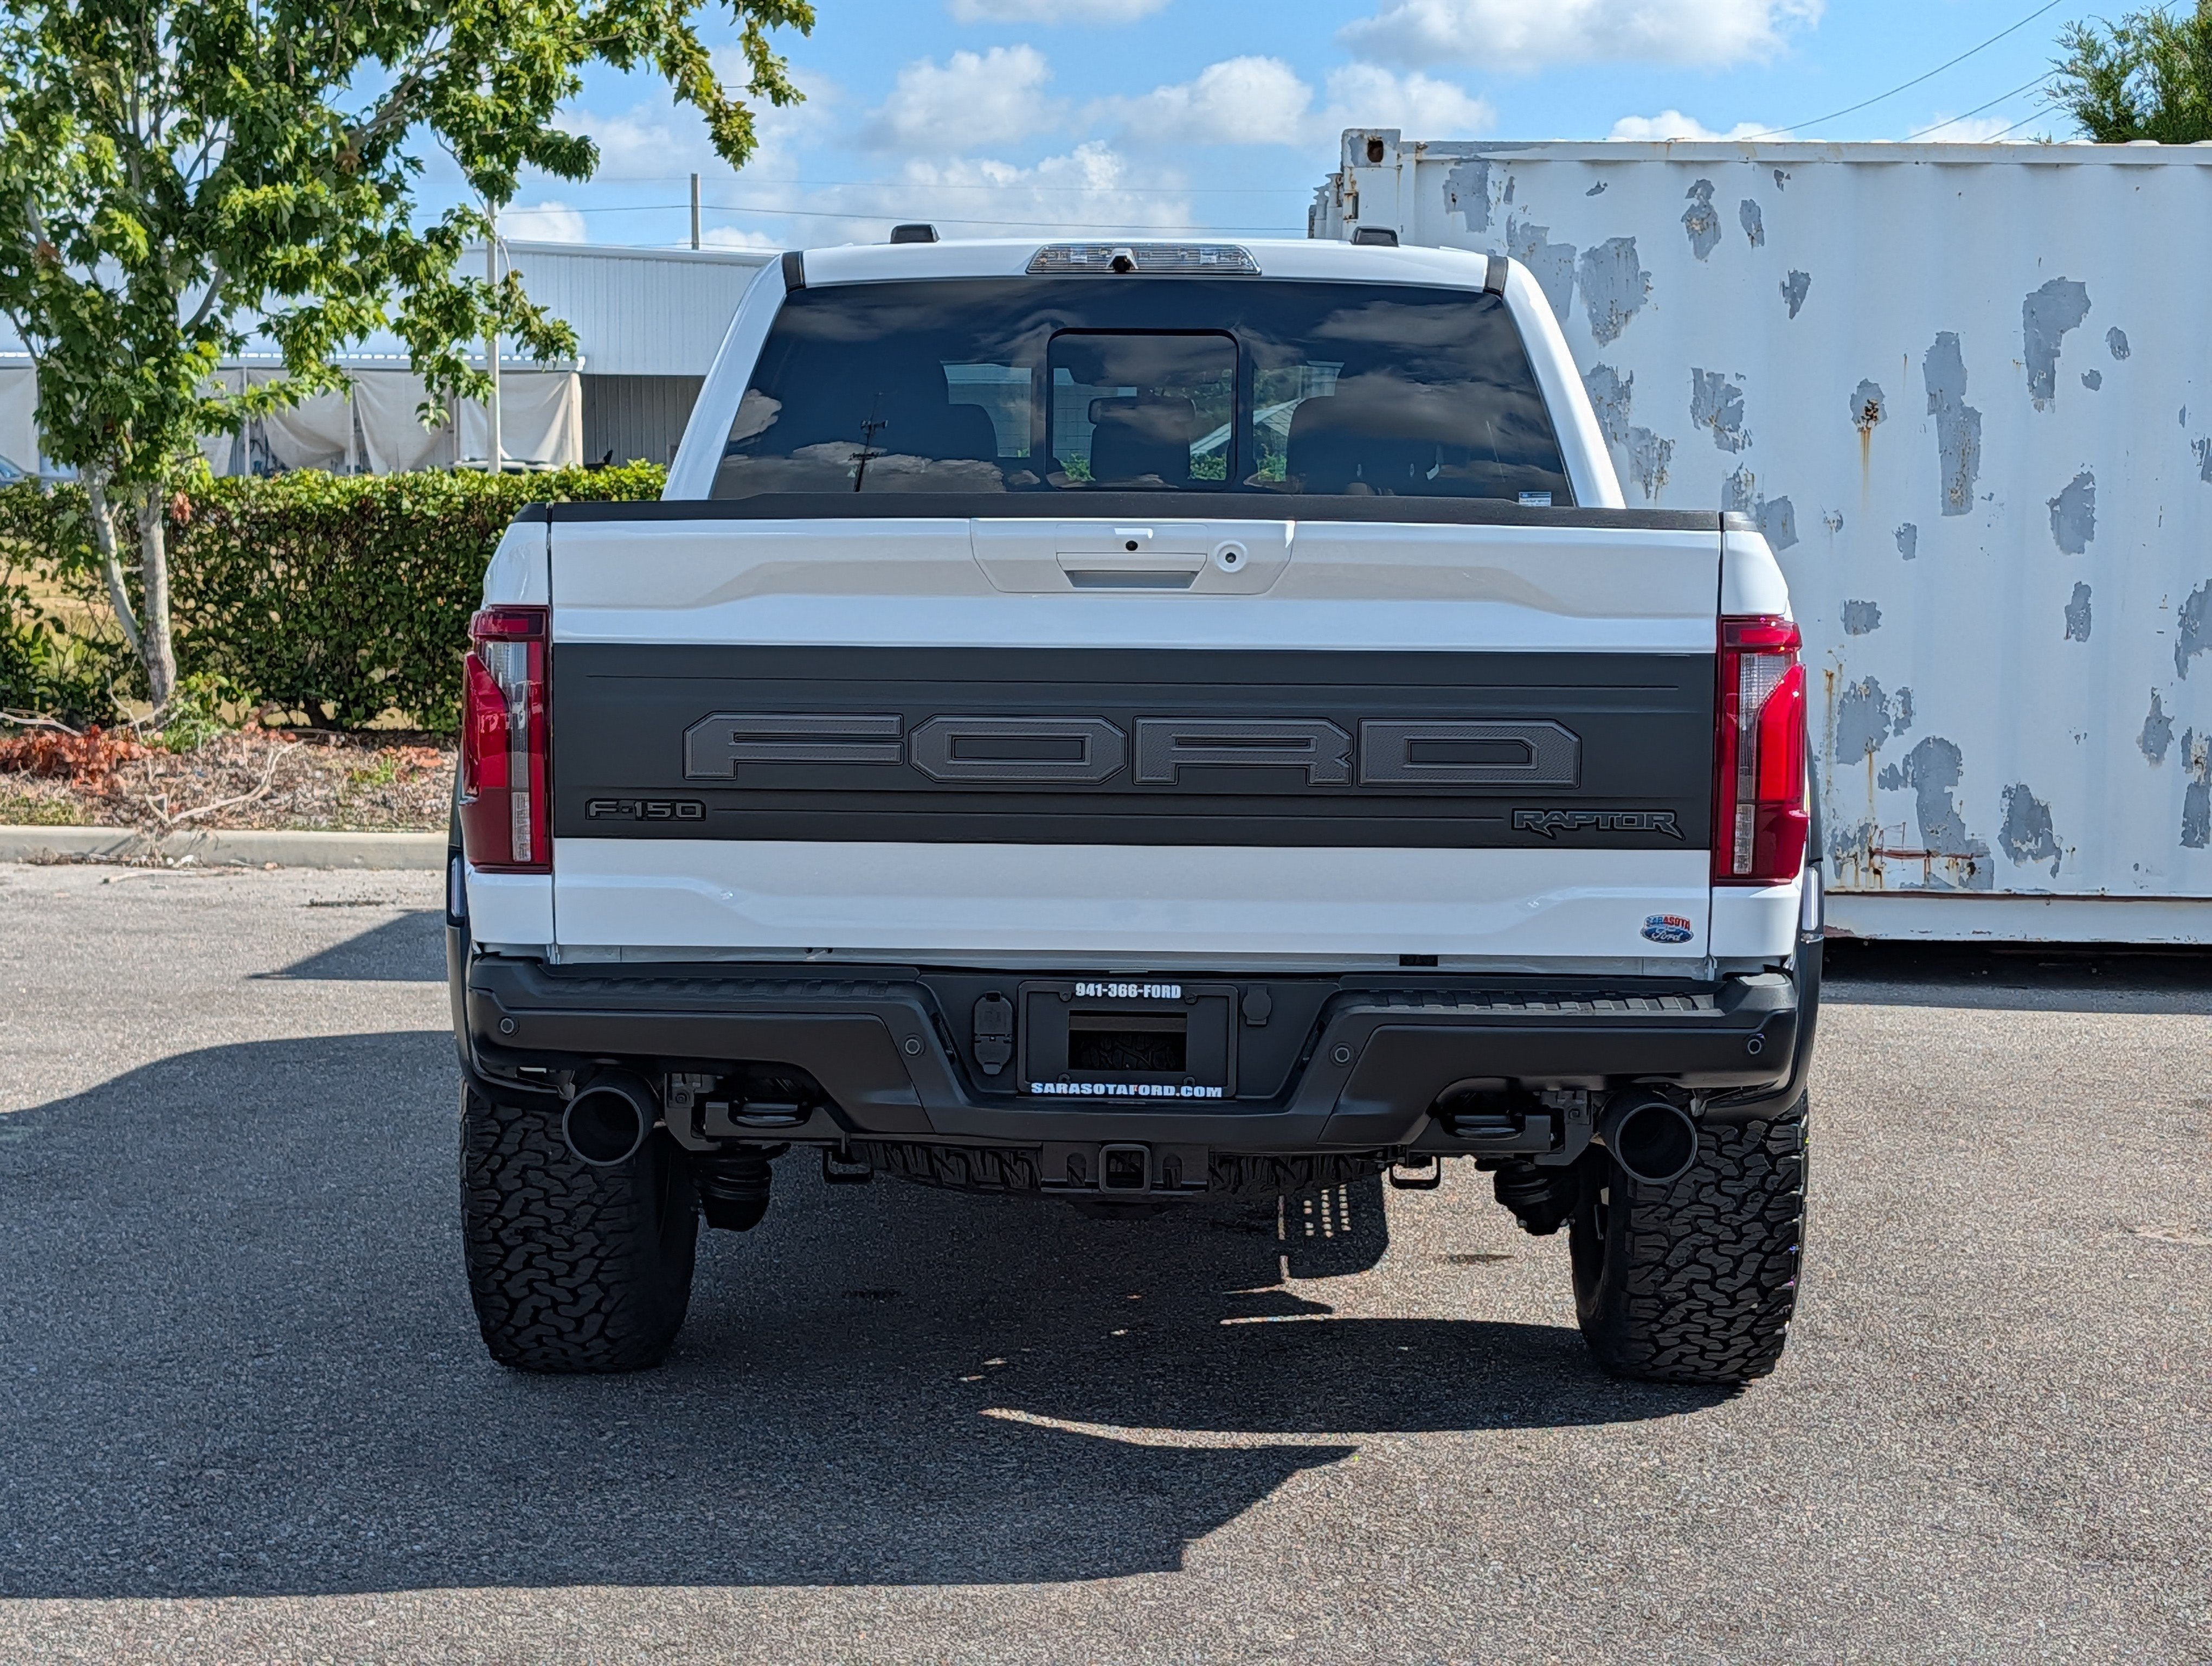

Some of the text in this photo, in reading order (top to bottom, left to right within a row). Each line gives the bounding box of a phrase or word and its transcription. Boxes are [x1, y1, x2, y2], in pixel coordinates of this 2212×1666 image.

[683, 710, 1582, 789] FORD
[587, 799, 705, 820] F-150
[1513, 809, 1686, 841] RAPTOR
[1646, 916, 1690, 931] SARASOTA
[1651, 925, 1684, 941] Ford
[1075, 983, 1181, 999] 941-366-FORD
[1031, 1083, 1223, 1098] SARASOTAFORD.COM
